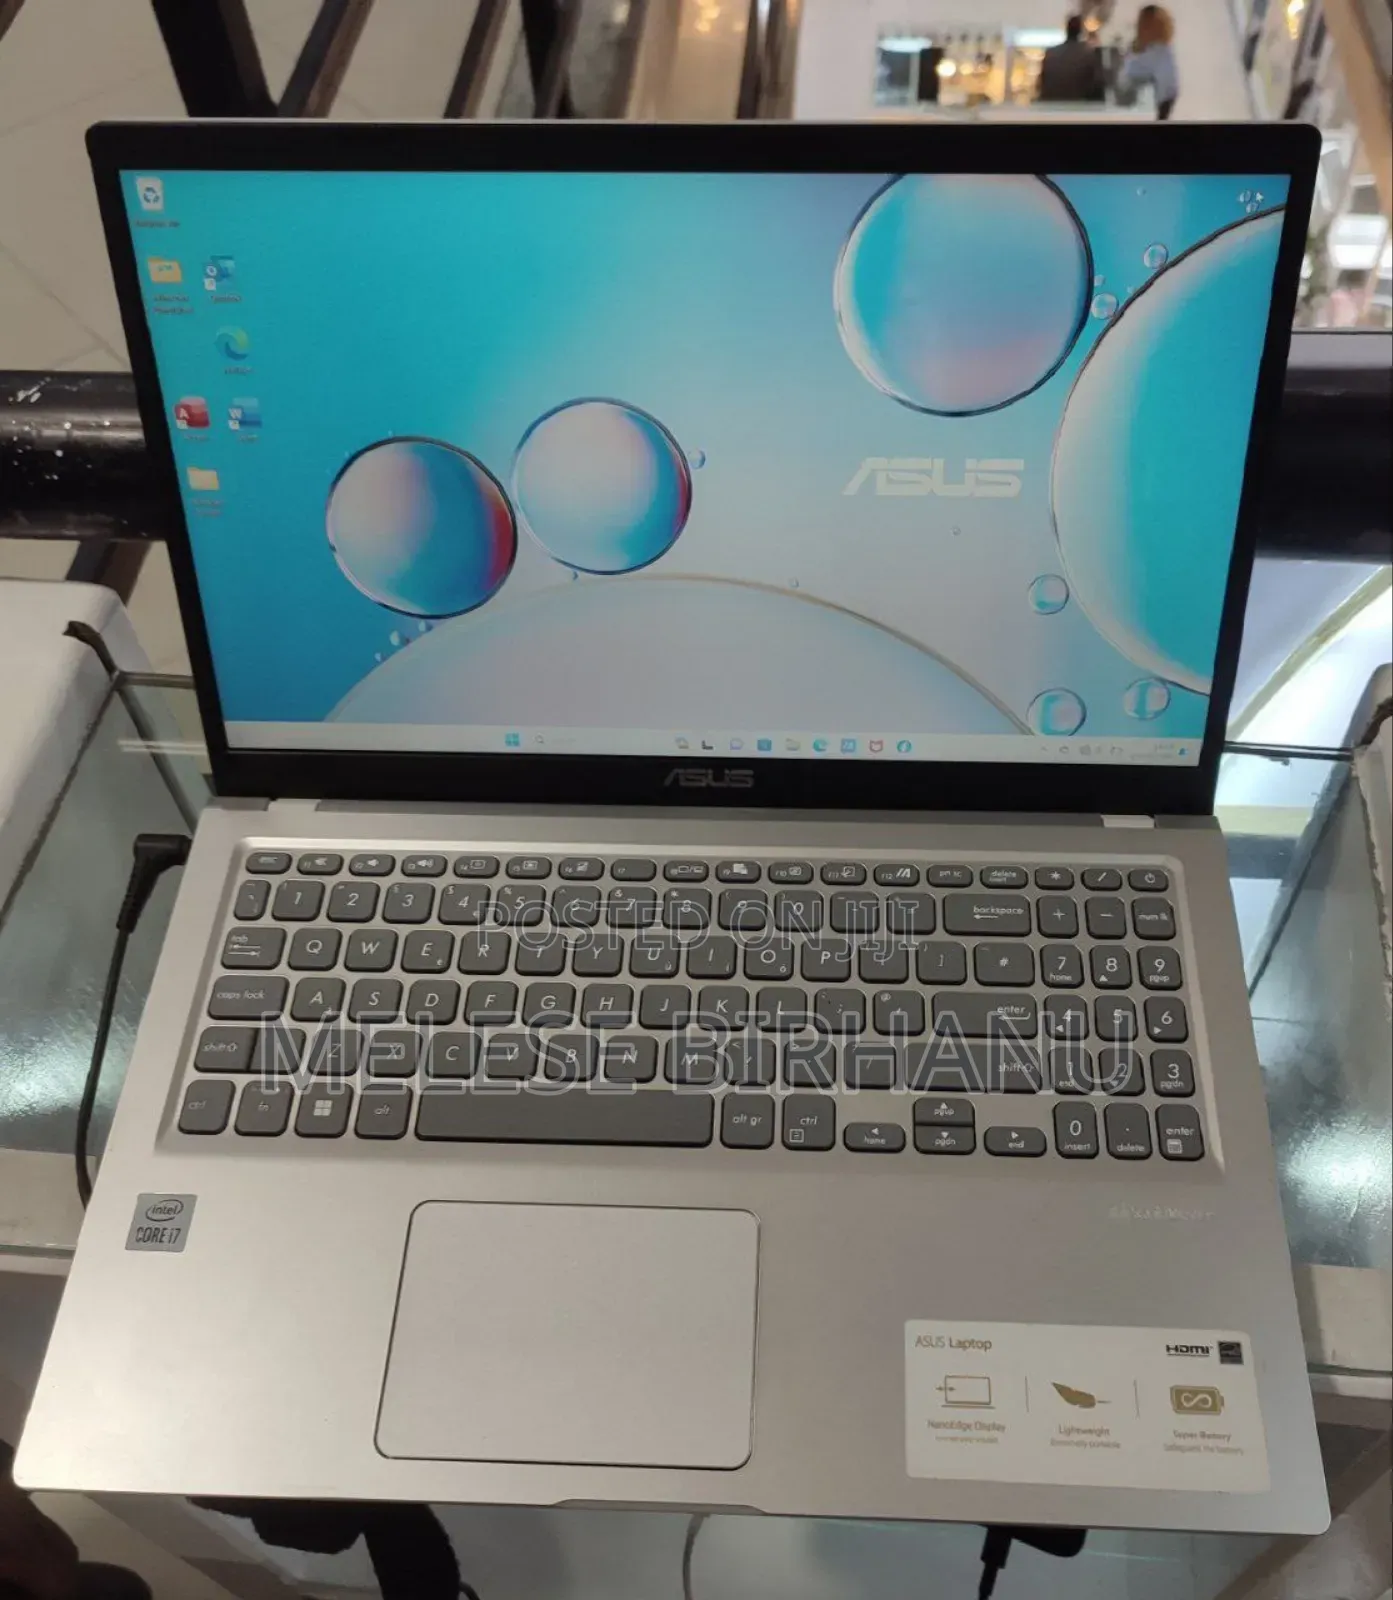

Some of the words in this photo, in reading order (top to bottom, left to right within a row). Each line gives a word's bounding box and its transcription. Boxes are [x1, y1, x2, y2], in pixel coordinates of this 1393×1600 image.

[843, 457, 1024, 497] ASUS
[664, 768, 754, 788] ASUS
[991, 869, 1017, 878] delete
[294, 892, 301, 905] 1
[346, 893, 359, 906] 2
[402, 894, 413, 907] 3
[458, 896, 469, 908] 4
[515, 896, 525, 909] 5
[626, 899, 636, 911] 7
[681, 901, 691, 913] 8
[973, 905, 1024, 915] backspace
[306, 940, 323, 955] Q
[361, 942, 379, 954] W
[421, 943, 433, 956] E
[478, 944, 490, 957] R
[536, 946, 546, 958] T
[593, 947, 604, 959] Y
[648, 948, 660, 961] U
[760, 950, 777, 964] O
[820, 952, 831, 964] P
[998, 957, 1009, 968] #
[1058, 957, 1067, 971] 7
[1106, 958, 1118, 971] 8
[1154, 959, 1166, 972] 9
[1049, 973, 1072, 981] home
[216, 991, 242, 1001] caps
[243, 990, 265, 1000] lock
[309, 991, 324, 1005] A
[369, 991, 381, 1006] S
[424, 994, 439, 1007] D
[484, 995, 496, 1008] F
[541, 995, 556, 1009] G
[599, 997, 614, 1010] H
[659, 998, 670, 1012] J
[716, 1000, 728, 1013] K
[776, 1001, 785, 1014] L
[997, 1004, 1026, 1015] enter
[1063, 1009, 1072, 1023] 4
[1112, 1009, 1124, 1024] 5
[1160, 1010, 1173, 1024] 6
[328, 1043, 341, 1058] Z
[387, 1044, 401, 1059] X
[445, 1045, 459, 1060] C
[506, 1046, 519, 1061] V
[565, 1048, 576, 1062] B
[622, 1050, 638, 1064] N
[682, 1052, 699, 1067] M
[998, 1063, 1023, 1072] shift
[1066, 1063, 1074, 1076] 1
[1116, 1064, 1127, 1078] 2
[1167, 1064, 1180, 1078] 3
[188, 1100, 206, 1110] ctrl
[374, 1104, 390, 1115] alt
[732, 1114, 747, 1124] alt
[750, 1116, 762, 1126] gr
[799, 1115, 817, 1125] ctrl
[1069, 1120, 1082, 1135] 0
[1165, 1128, 1194, 1137] enter
[863, 1137, 886, 1145] home
[1008, 1139, 1024, 1149] end
[1064, 1142, 1091, 1151] insert
[1116, 1143, 1145, 1152] delete
[152, 1205, 178, 1215] intel
[135, 1227, 168, 1243] CORE
[168, 1228, 181, 1244] i7
[915, 1335, 945, 1348] ASUS
[949, 1336, 992, 1352] Laptop
[1166, 1344, 1209, 1354] HDMI
[927, 1419, 972, 1431] NanoEdge
[974, 1421, 1006, 1432] Display
[1059, 1424, 1110, 1437] Lightweight
[1199, 1431, 1231, 1443] Battery
